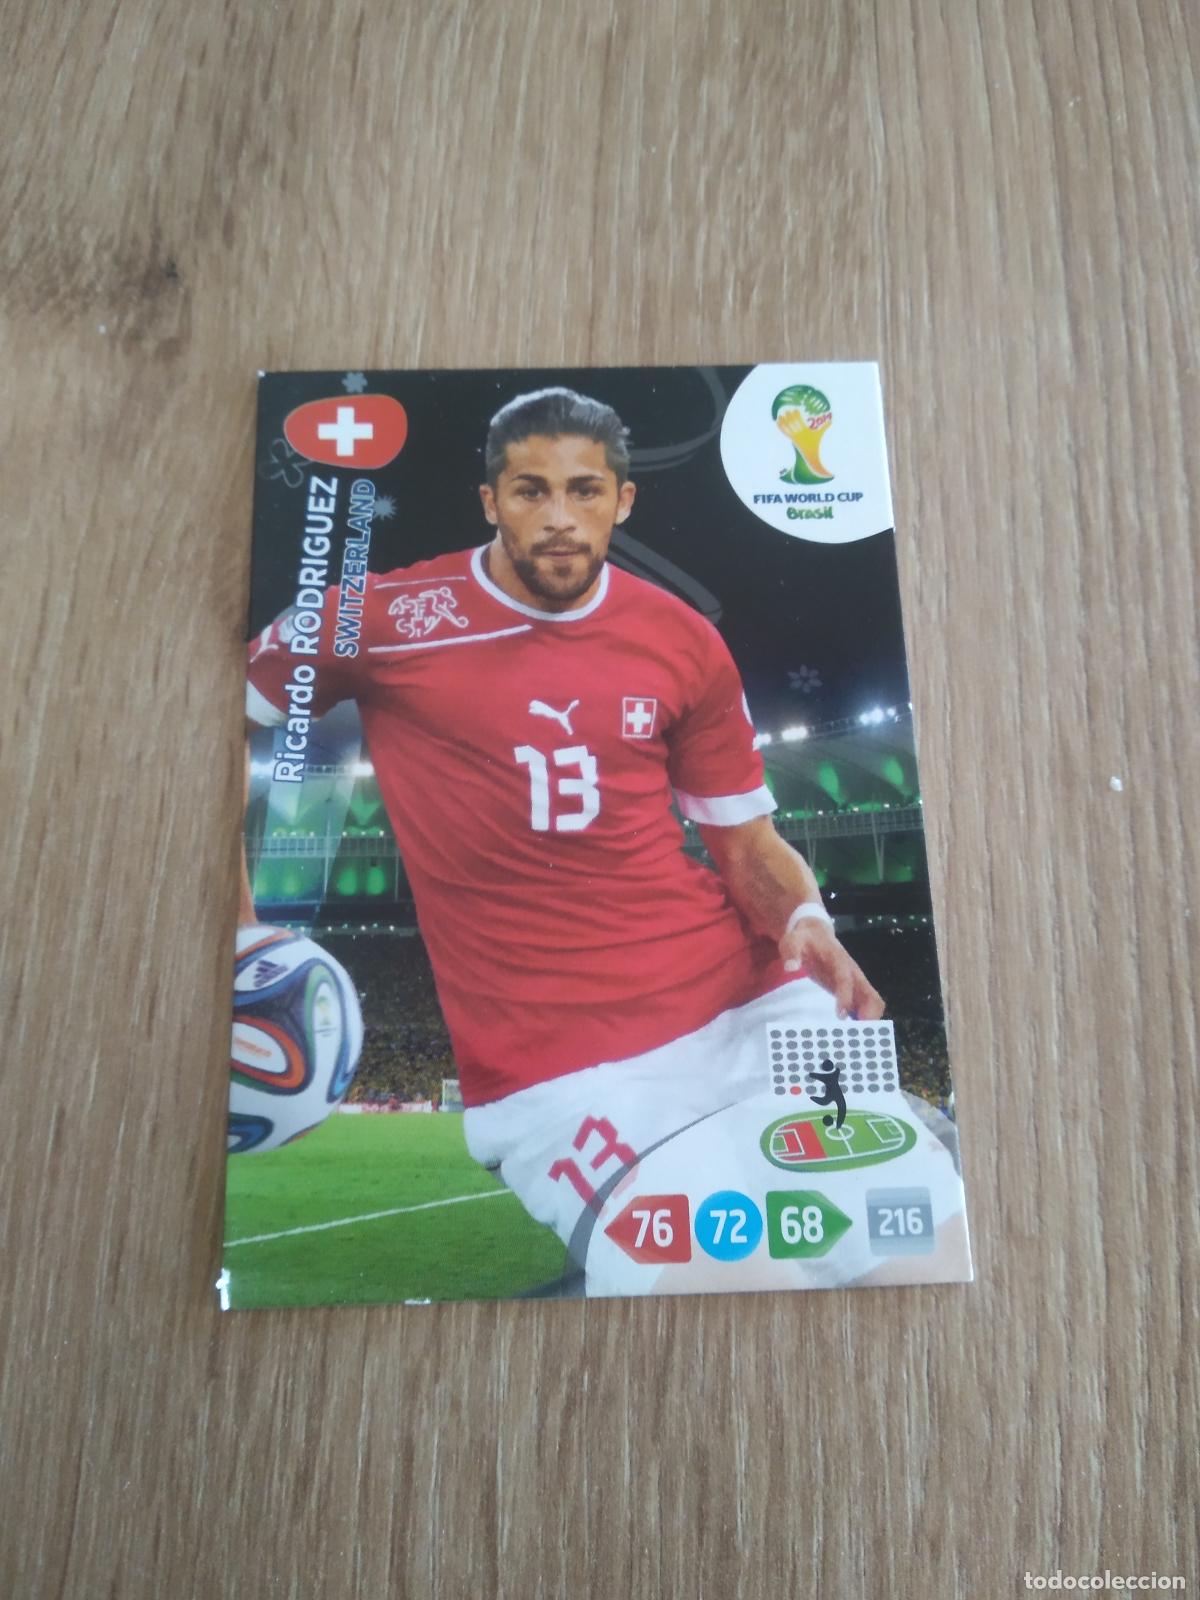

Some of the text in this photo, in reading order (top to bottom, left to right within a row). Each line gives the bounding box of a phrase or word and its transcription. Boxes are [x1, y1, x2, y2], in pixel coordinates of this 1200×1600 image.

[753, 492, 863, 504] FIFA WORLD CUP
[786, 506, 834, 520] Brasil
[334, 479, 376, 658] SWITZERLAND
[273, 475, 339, 782] Ricardo RODRIGUEZ
[513, 745, 600, 832] 13
[548, 1114, 640, 1212] 13
[632, 1206, 924, 1248] 76 72 68 216
